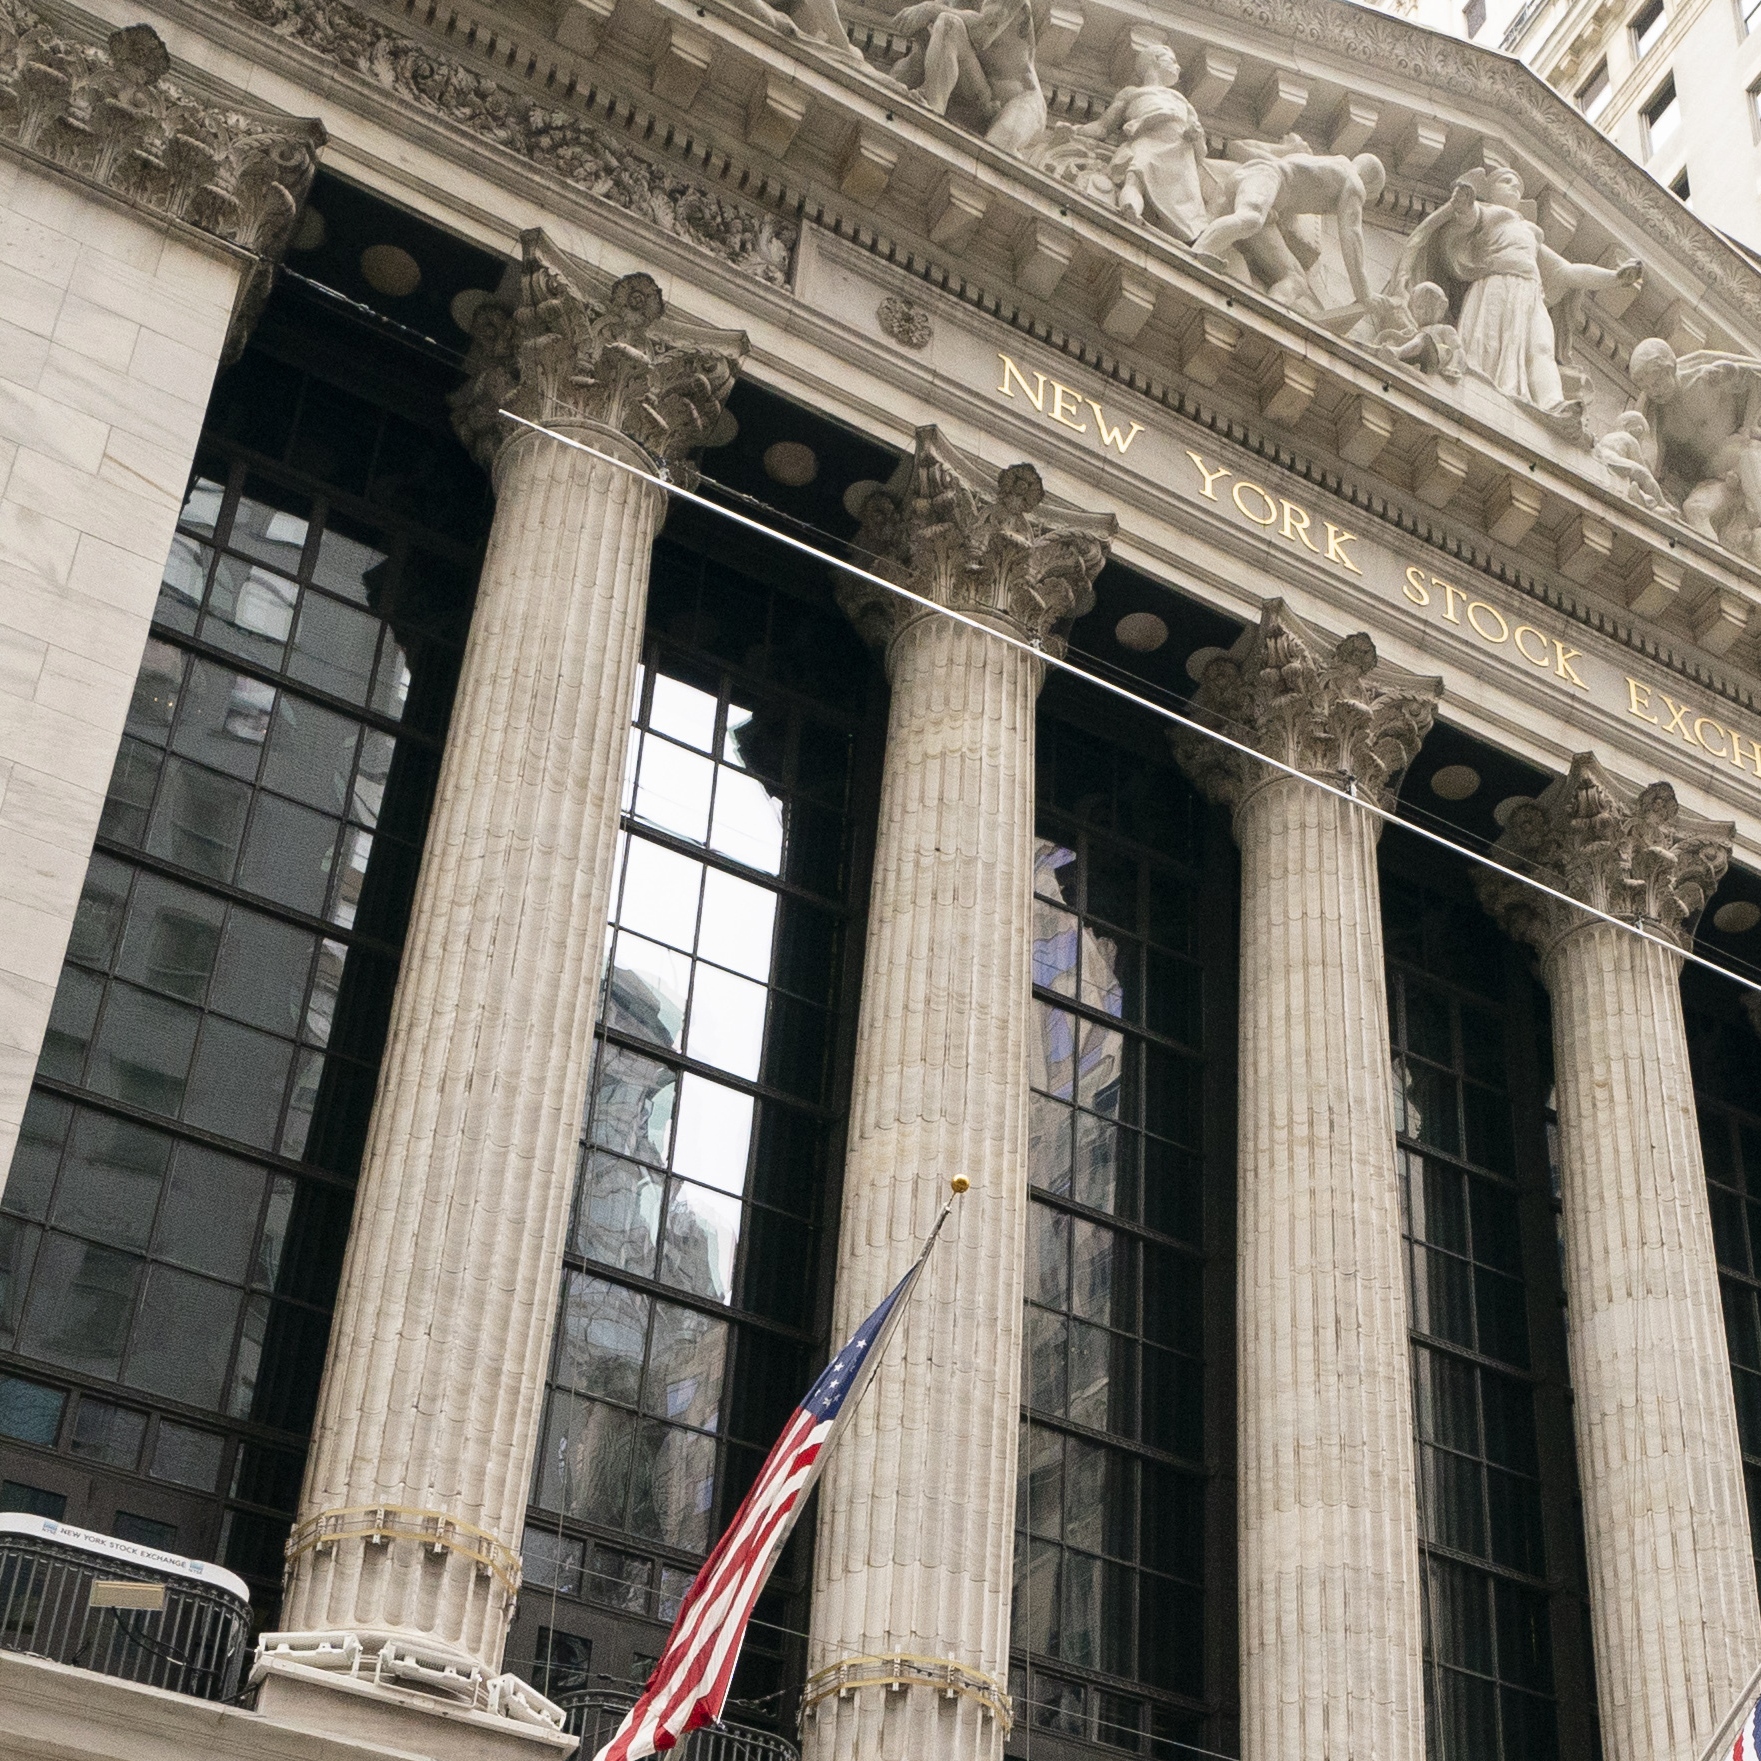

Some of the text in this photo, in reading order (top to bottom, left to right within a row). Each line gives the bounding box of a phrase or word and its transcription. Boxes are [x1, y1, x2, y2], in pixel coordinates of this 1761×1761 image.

[997, 352, 1145, 454] NEW
[1186, 450, 1363, 575] YORK
[1402, 566, 1590, 692] STOCK
[60, 1527, 187, 1568] NEW YORK STOCK EXCHANGE
